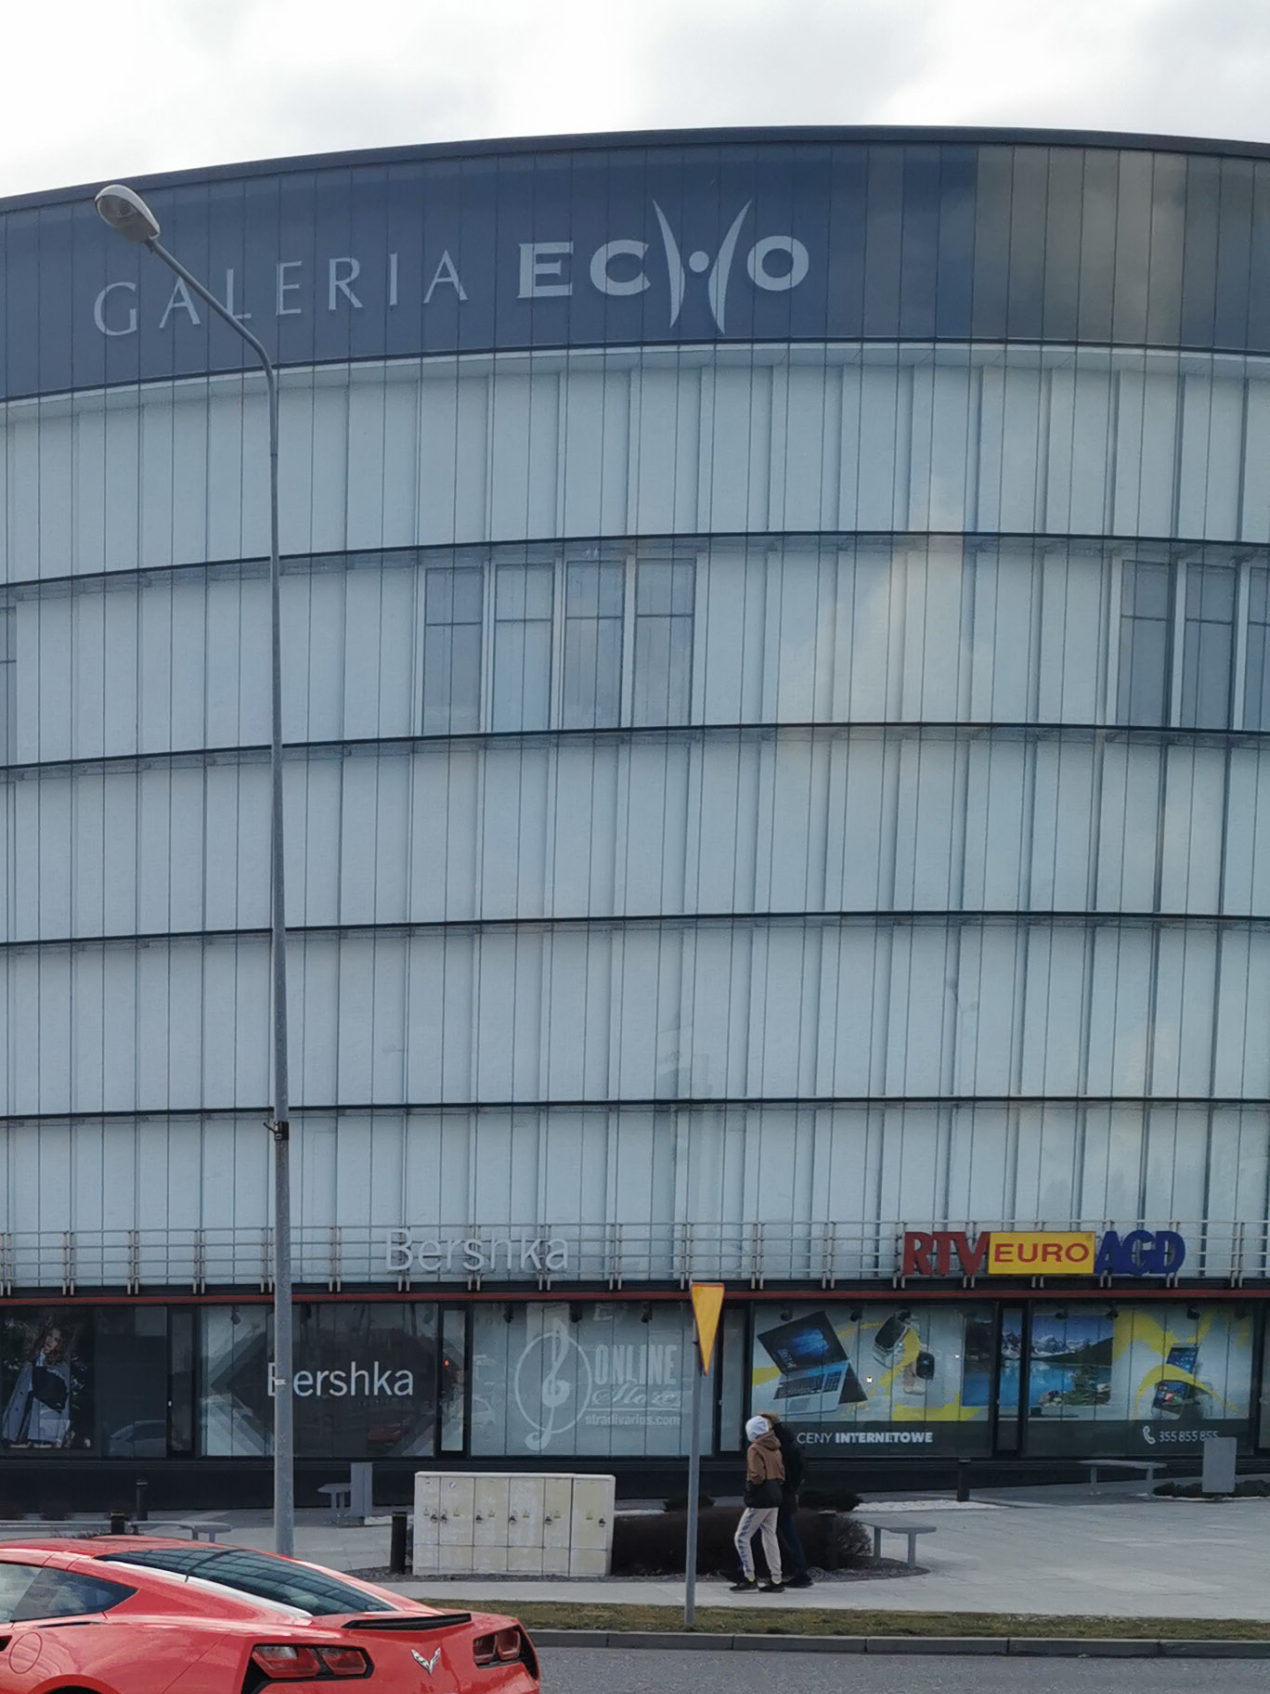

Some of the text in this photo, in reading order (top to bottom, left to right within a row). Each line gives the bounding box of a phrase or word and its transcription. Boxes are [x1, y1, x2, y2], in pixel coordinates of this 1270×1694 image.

[94, 199, 811, 337] GALERIA ECHO
[385, 1230, 569, 1271] Bershka
[902, 1230, 1186, 1276] RTV EURO AGD
[594, 1344, 678, 1385] ONLINE
[585, 1413, 680, 1426] stradivarius.com
[796, 1432, 933, 1444] CENY INTERNETOWE
[1159, 1430, 1177, 1442] 355
[1178, 1430, 1198, 1442] 855
